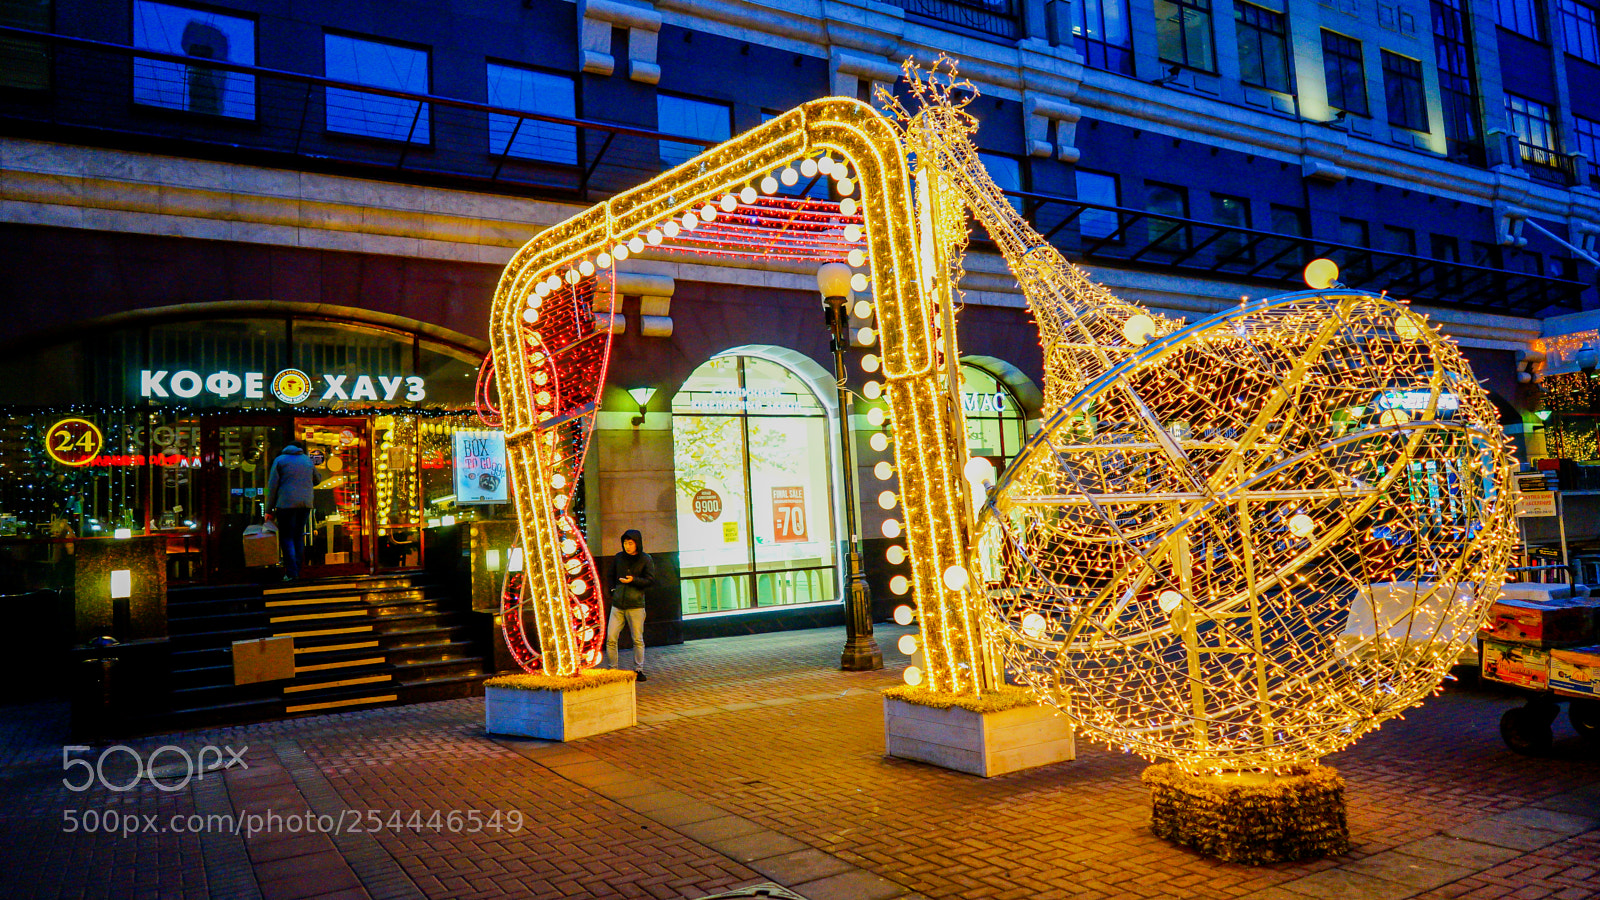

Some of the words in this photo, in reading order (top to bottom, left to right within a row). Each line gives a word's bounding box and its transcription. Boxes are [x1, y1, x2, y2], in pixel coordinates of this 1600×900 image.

[141, 370, 264, 398] КОФЕ
[321, 375, 426, 401] ХАУЗ
[54, 430, 96, 452] 24
[463, 438, 489, 457] BOX
[465, 458, 478, 469] TO
[480, 457, 491, 469] GO
[773, 490, 788, 498] FINAL
[789, 489, 803, 499] SALE
